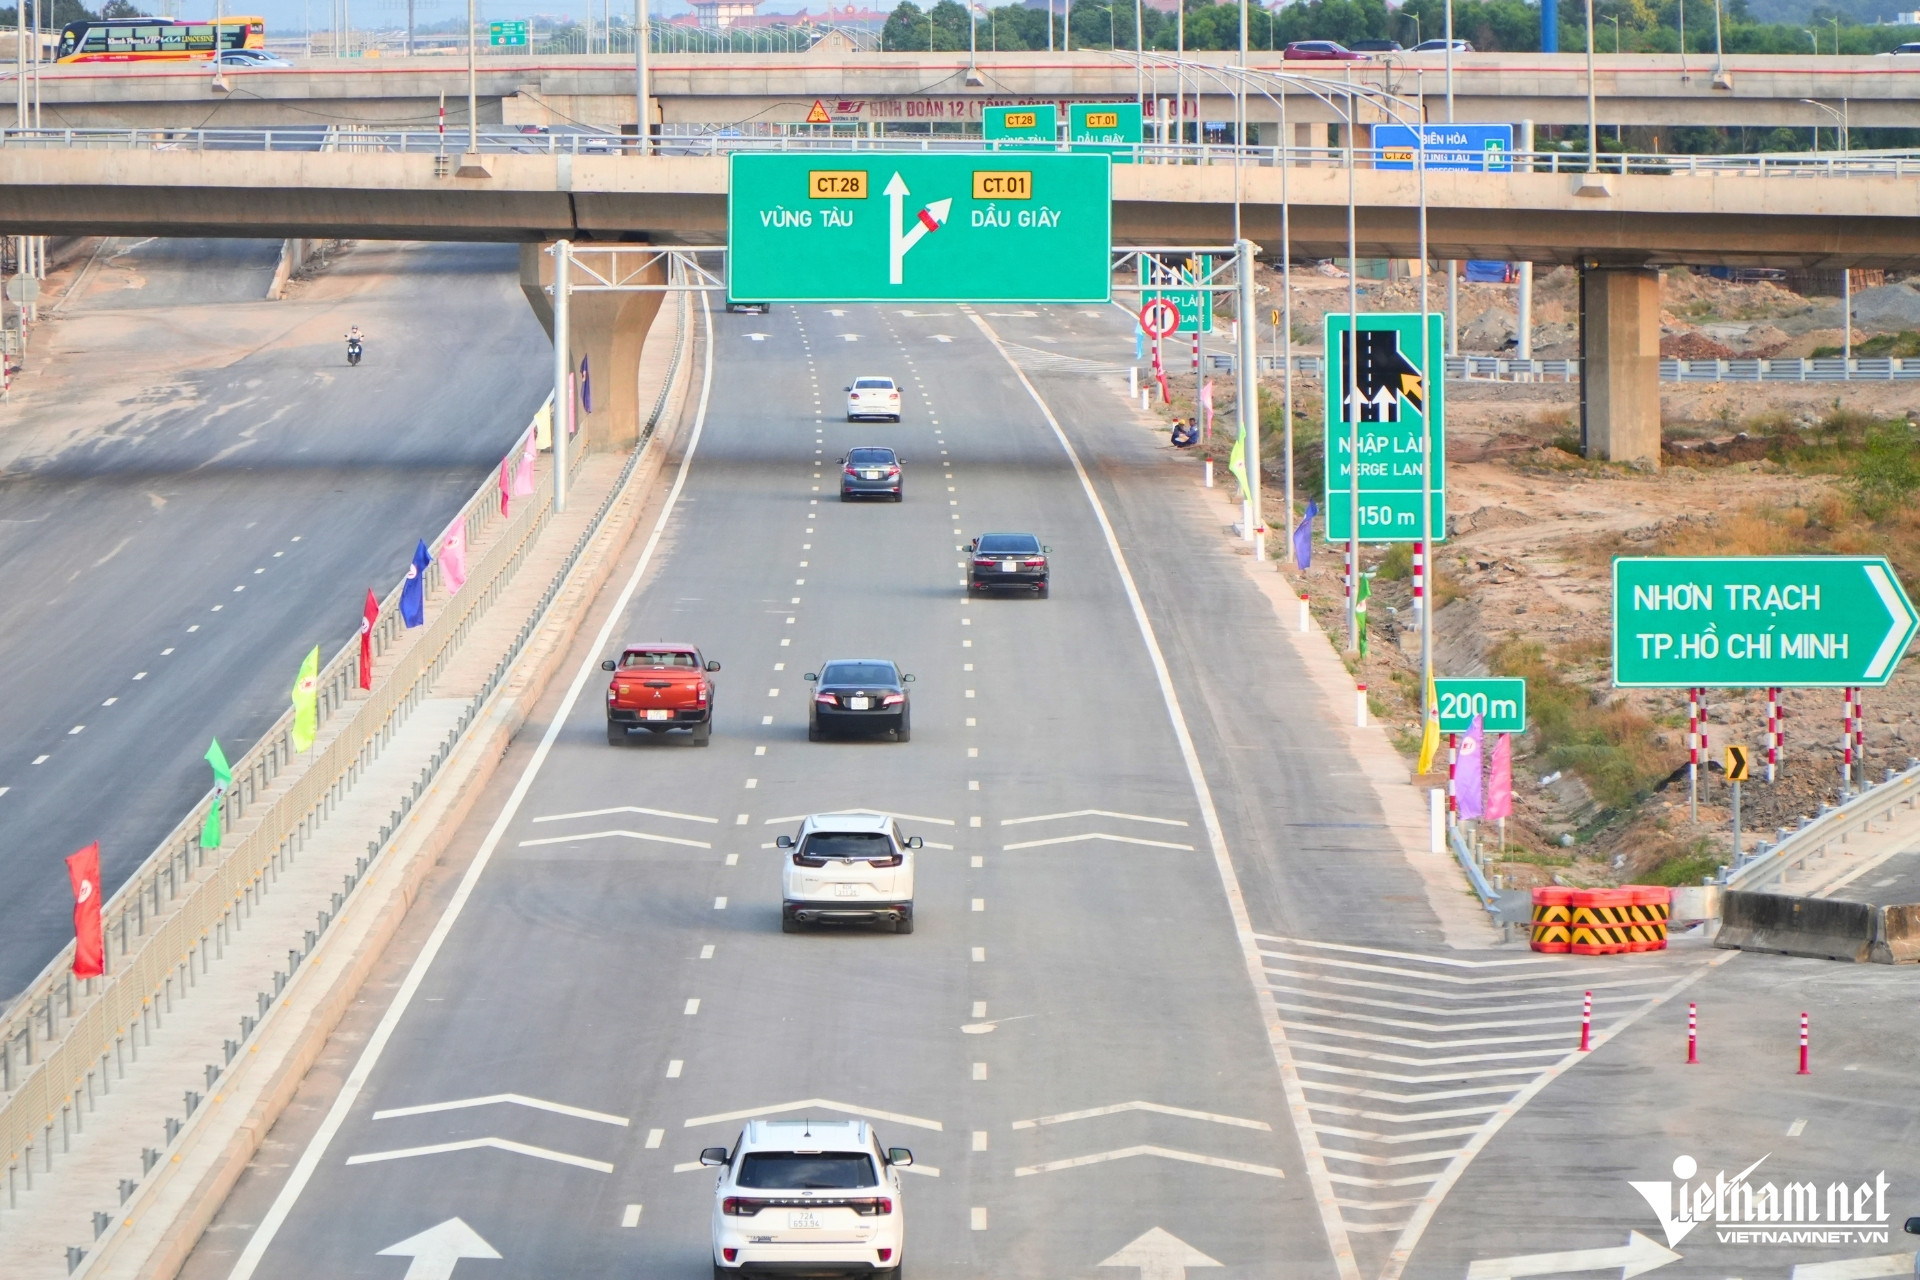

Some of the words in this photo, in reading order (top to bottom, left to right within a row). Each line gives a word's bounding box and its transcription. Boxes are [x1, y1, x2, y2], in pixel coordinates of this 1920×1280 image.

[144, 35, 160, 44] VIP
[181, 35, 215, 43] LIMOUSINE
[906, 98, 944, 117] ĐOÀN
[948, 100, 965, 117] 12
[1007, 115, 1033, 125] CT.28
[1088, 115, 1115, 125] CT.01
[1422, 131, 1444, 145] BIÊN
[1446, 131, 1468, 145] HÒA
[817, 177, 860, 193] CT.28
[983, 177, 1025, 194] CT.01
[759, 205, 812, 227] VŨNG
[820, 206, 853, 227] TÀU
[971, 202, 1011, 228] DẦU
[1018, 205, 1062, 227] GIÂY
[1358, 505, 1392, 526] 150
[1397, 511, 1415, 526] m
[1634, 581, 1713, 611] NHƠN
[1724, 584, 1820, 617] TRẠCH
[1636, 622, 1719, 660] TP.HỒ
[1727, 624, 1776, 660] CHÍ
[1781, 633, 1849, 659] MINH
